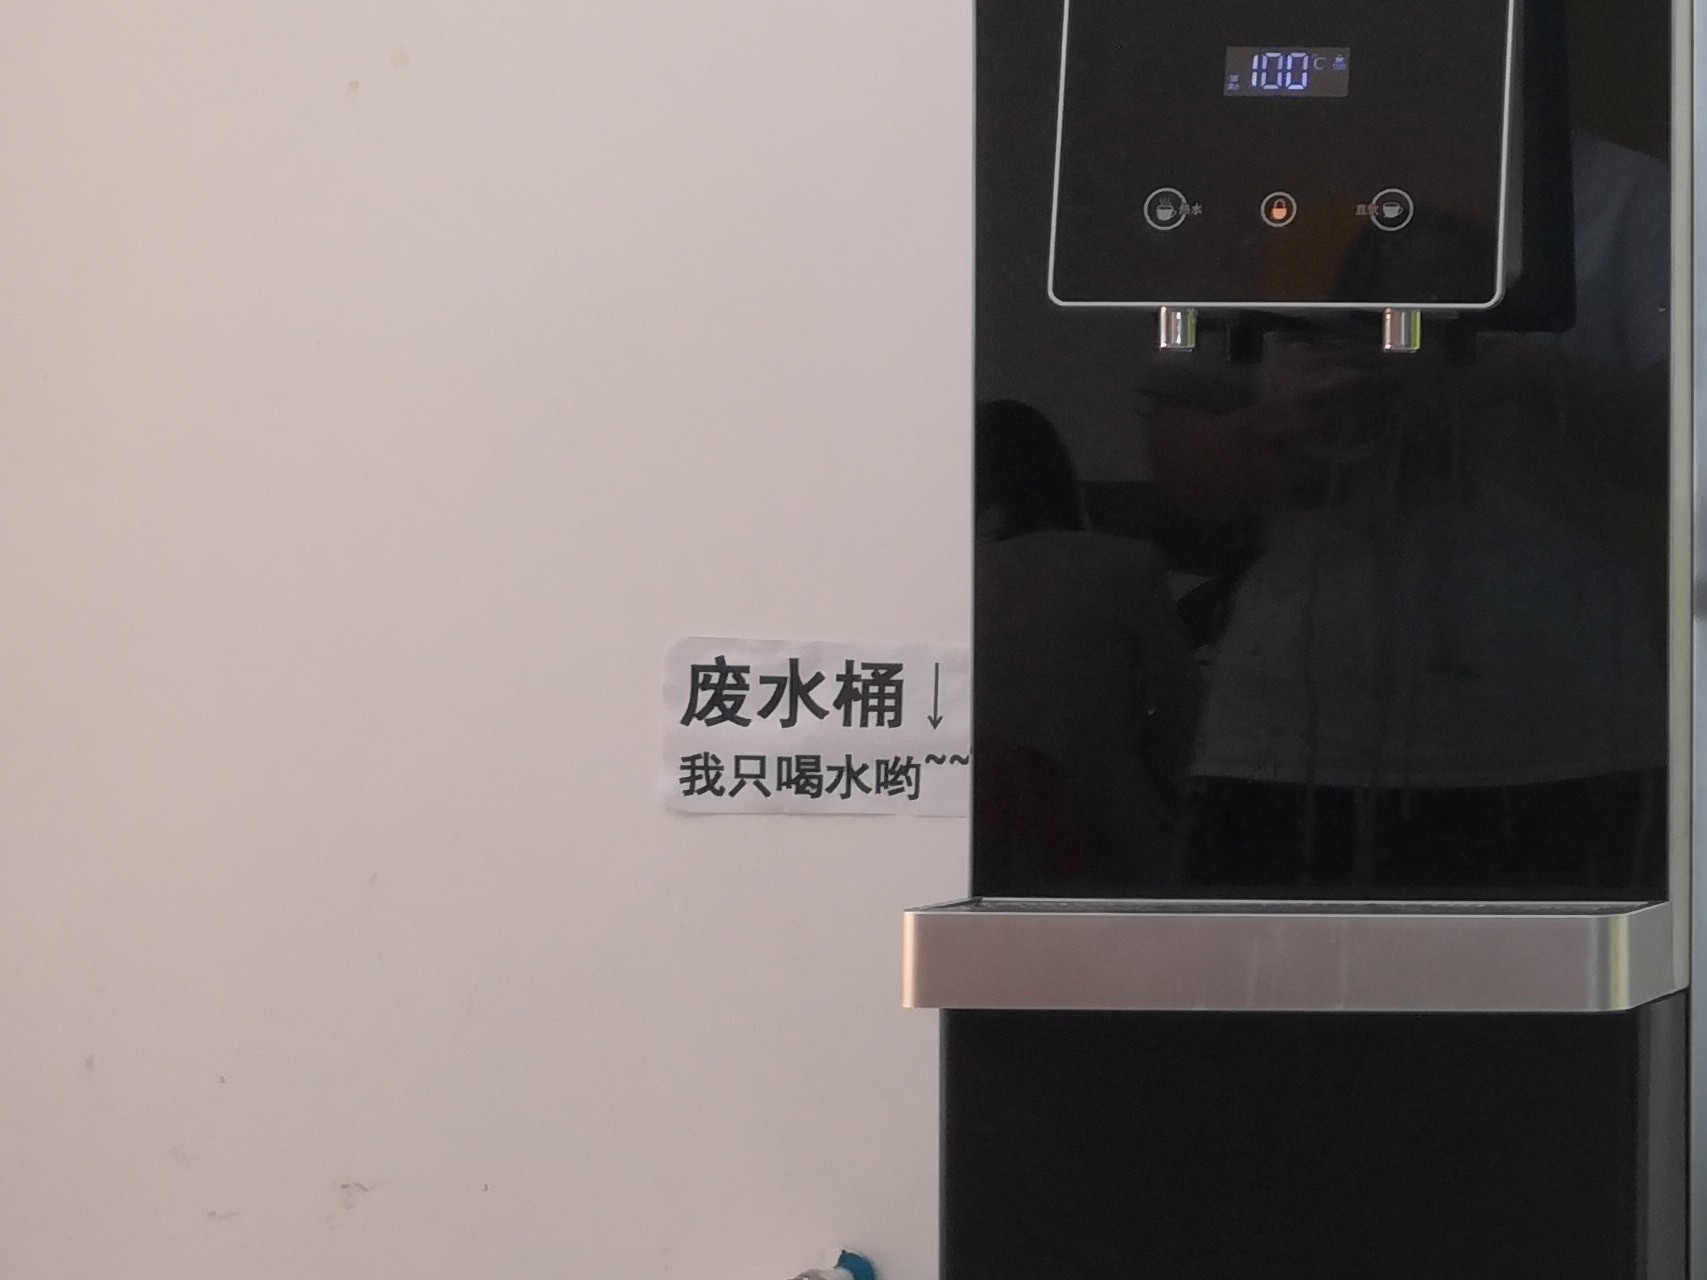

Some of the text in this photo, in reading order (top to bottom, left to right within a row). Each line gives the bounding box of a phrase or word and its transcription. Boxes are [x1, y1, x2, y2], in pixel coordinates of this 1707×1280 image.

[1252, 52, 1309, 90] 100
[680, 655, 903, 728] 废水桶
